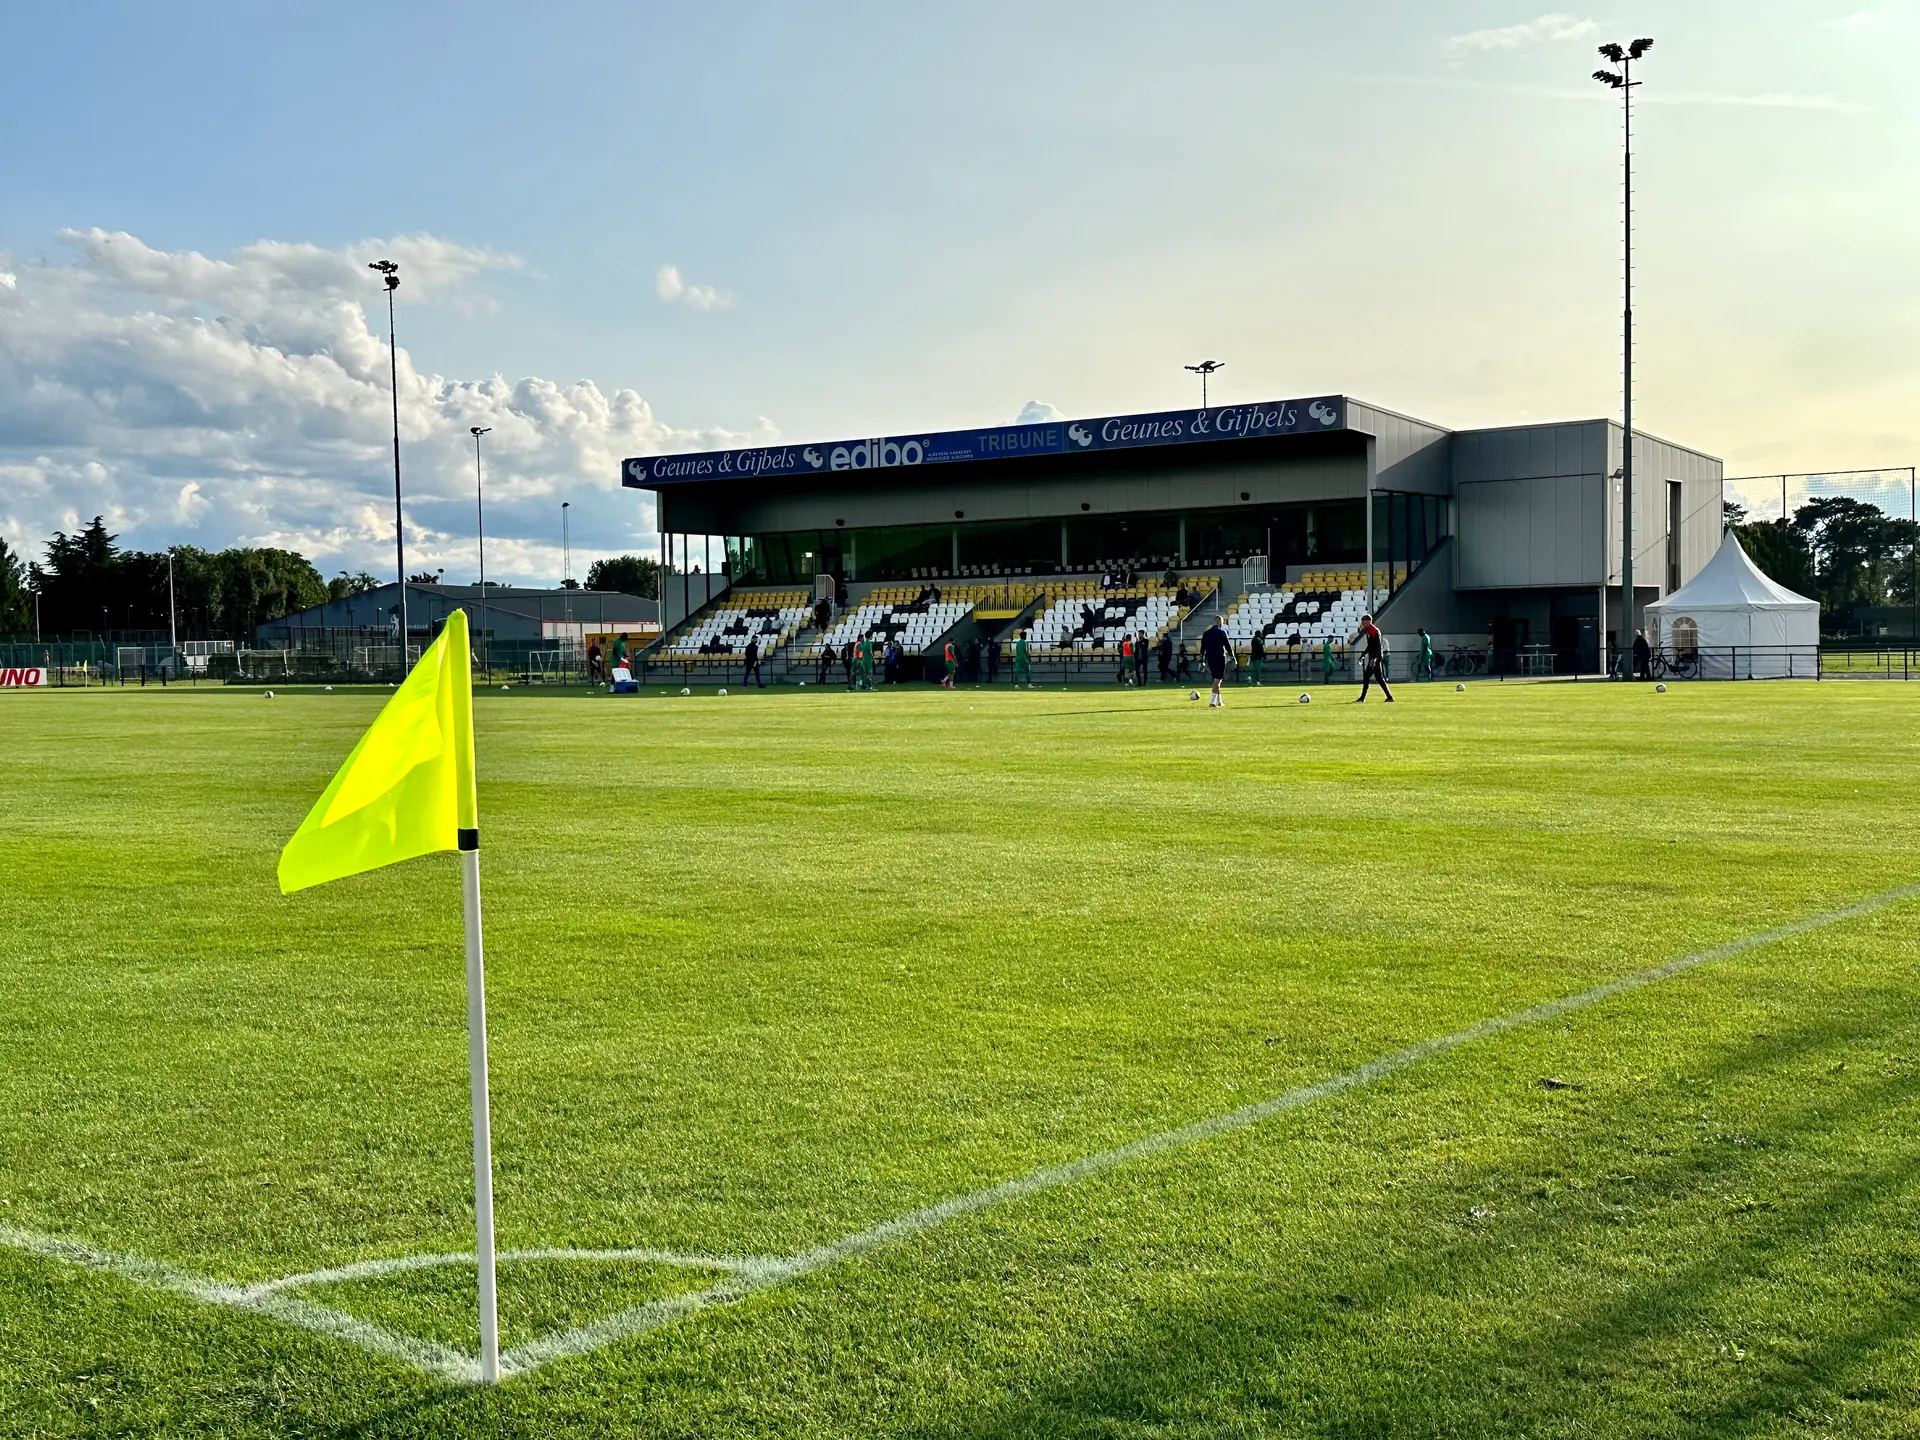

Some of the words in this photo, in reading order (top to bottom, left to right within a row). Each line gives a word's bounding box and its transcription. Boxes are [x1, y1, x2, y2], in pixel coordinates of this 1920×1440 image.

[1101, 419, 1183, 441] Geunes
[1190, 410, 1210, 434] &
[1215, 403, 1297, 436] Gijbels
[831, 438, 922, 470] edibo
[978, 430, 1057, 452] TRIBUNE
[653, 457, 713, 478] Geunes
[718, 453, 733, 472] &
[736, 448, 796, 475] Gijbels
